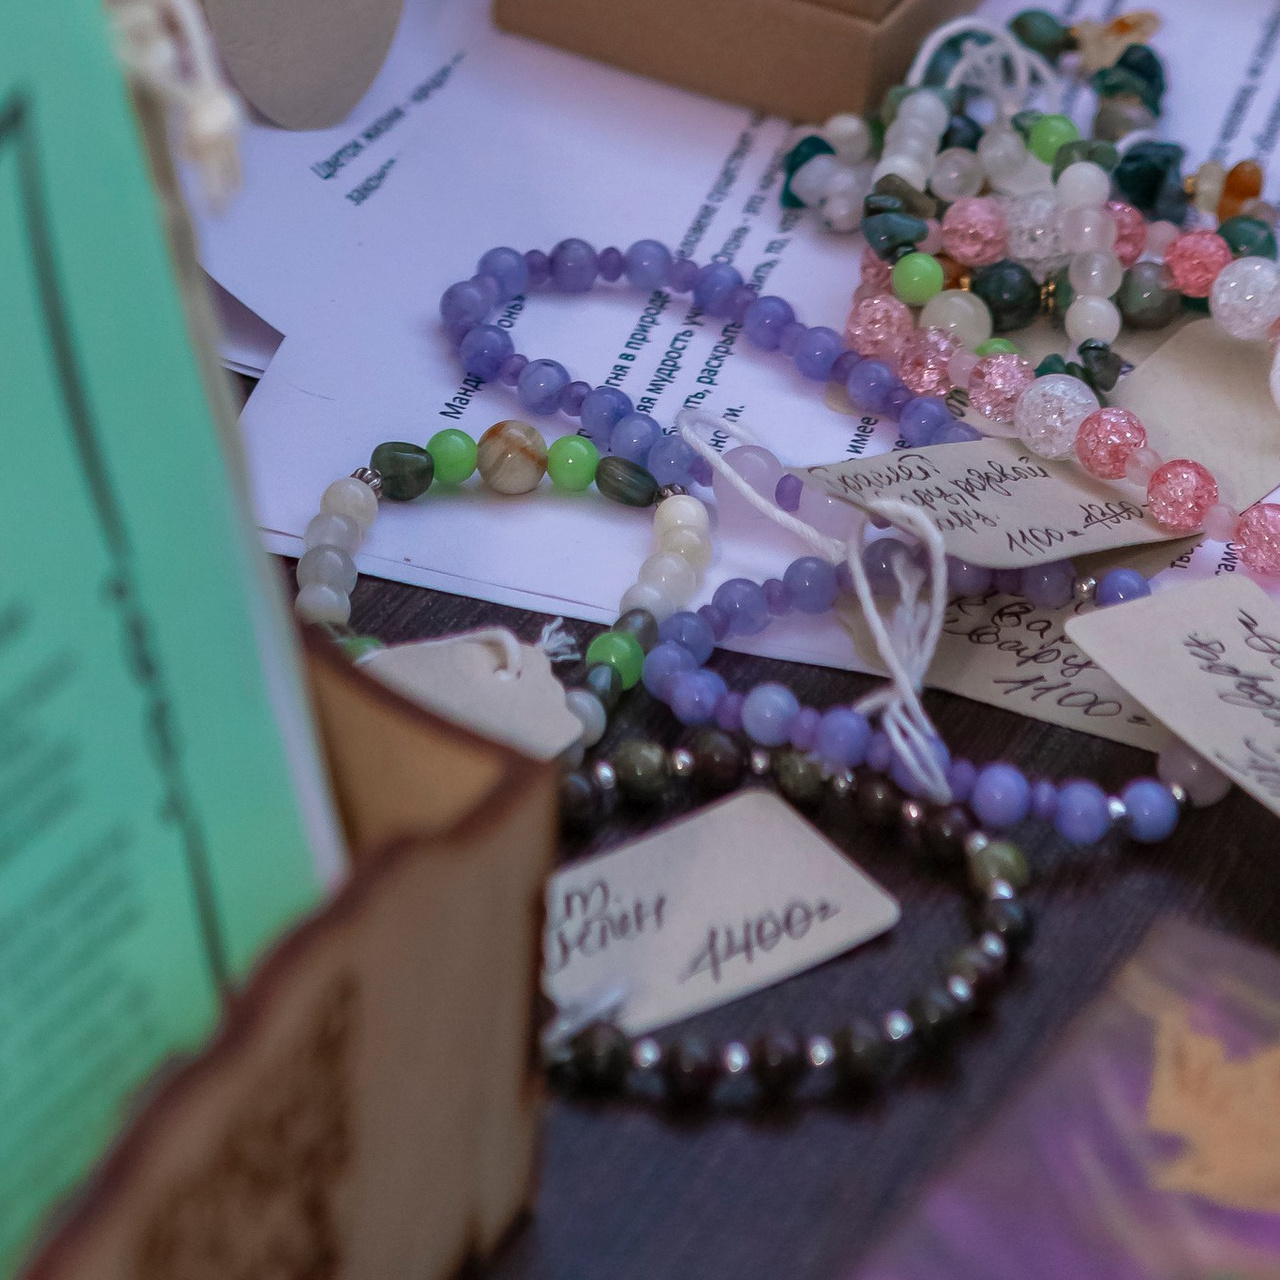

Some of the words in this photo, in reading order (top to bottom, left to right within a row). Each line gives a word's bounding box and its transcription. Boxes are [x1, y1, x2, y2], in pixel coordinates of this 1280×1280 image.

[625, 290, 670, 352] природе
[618, 352, 636, 362] в
[646, 329, 694, 395] мудрость
